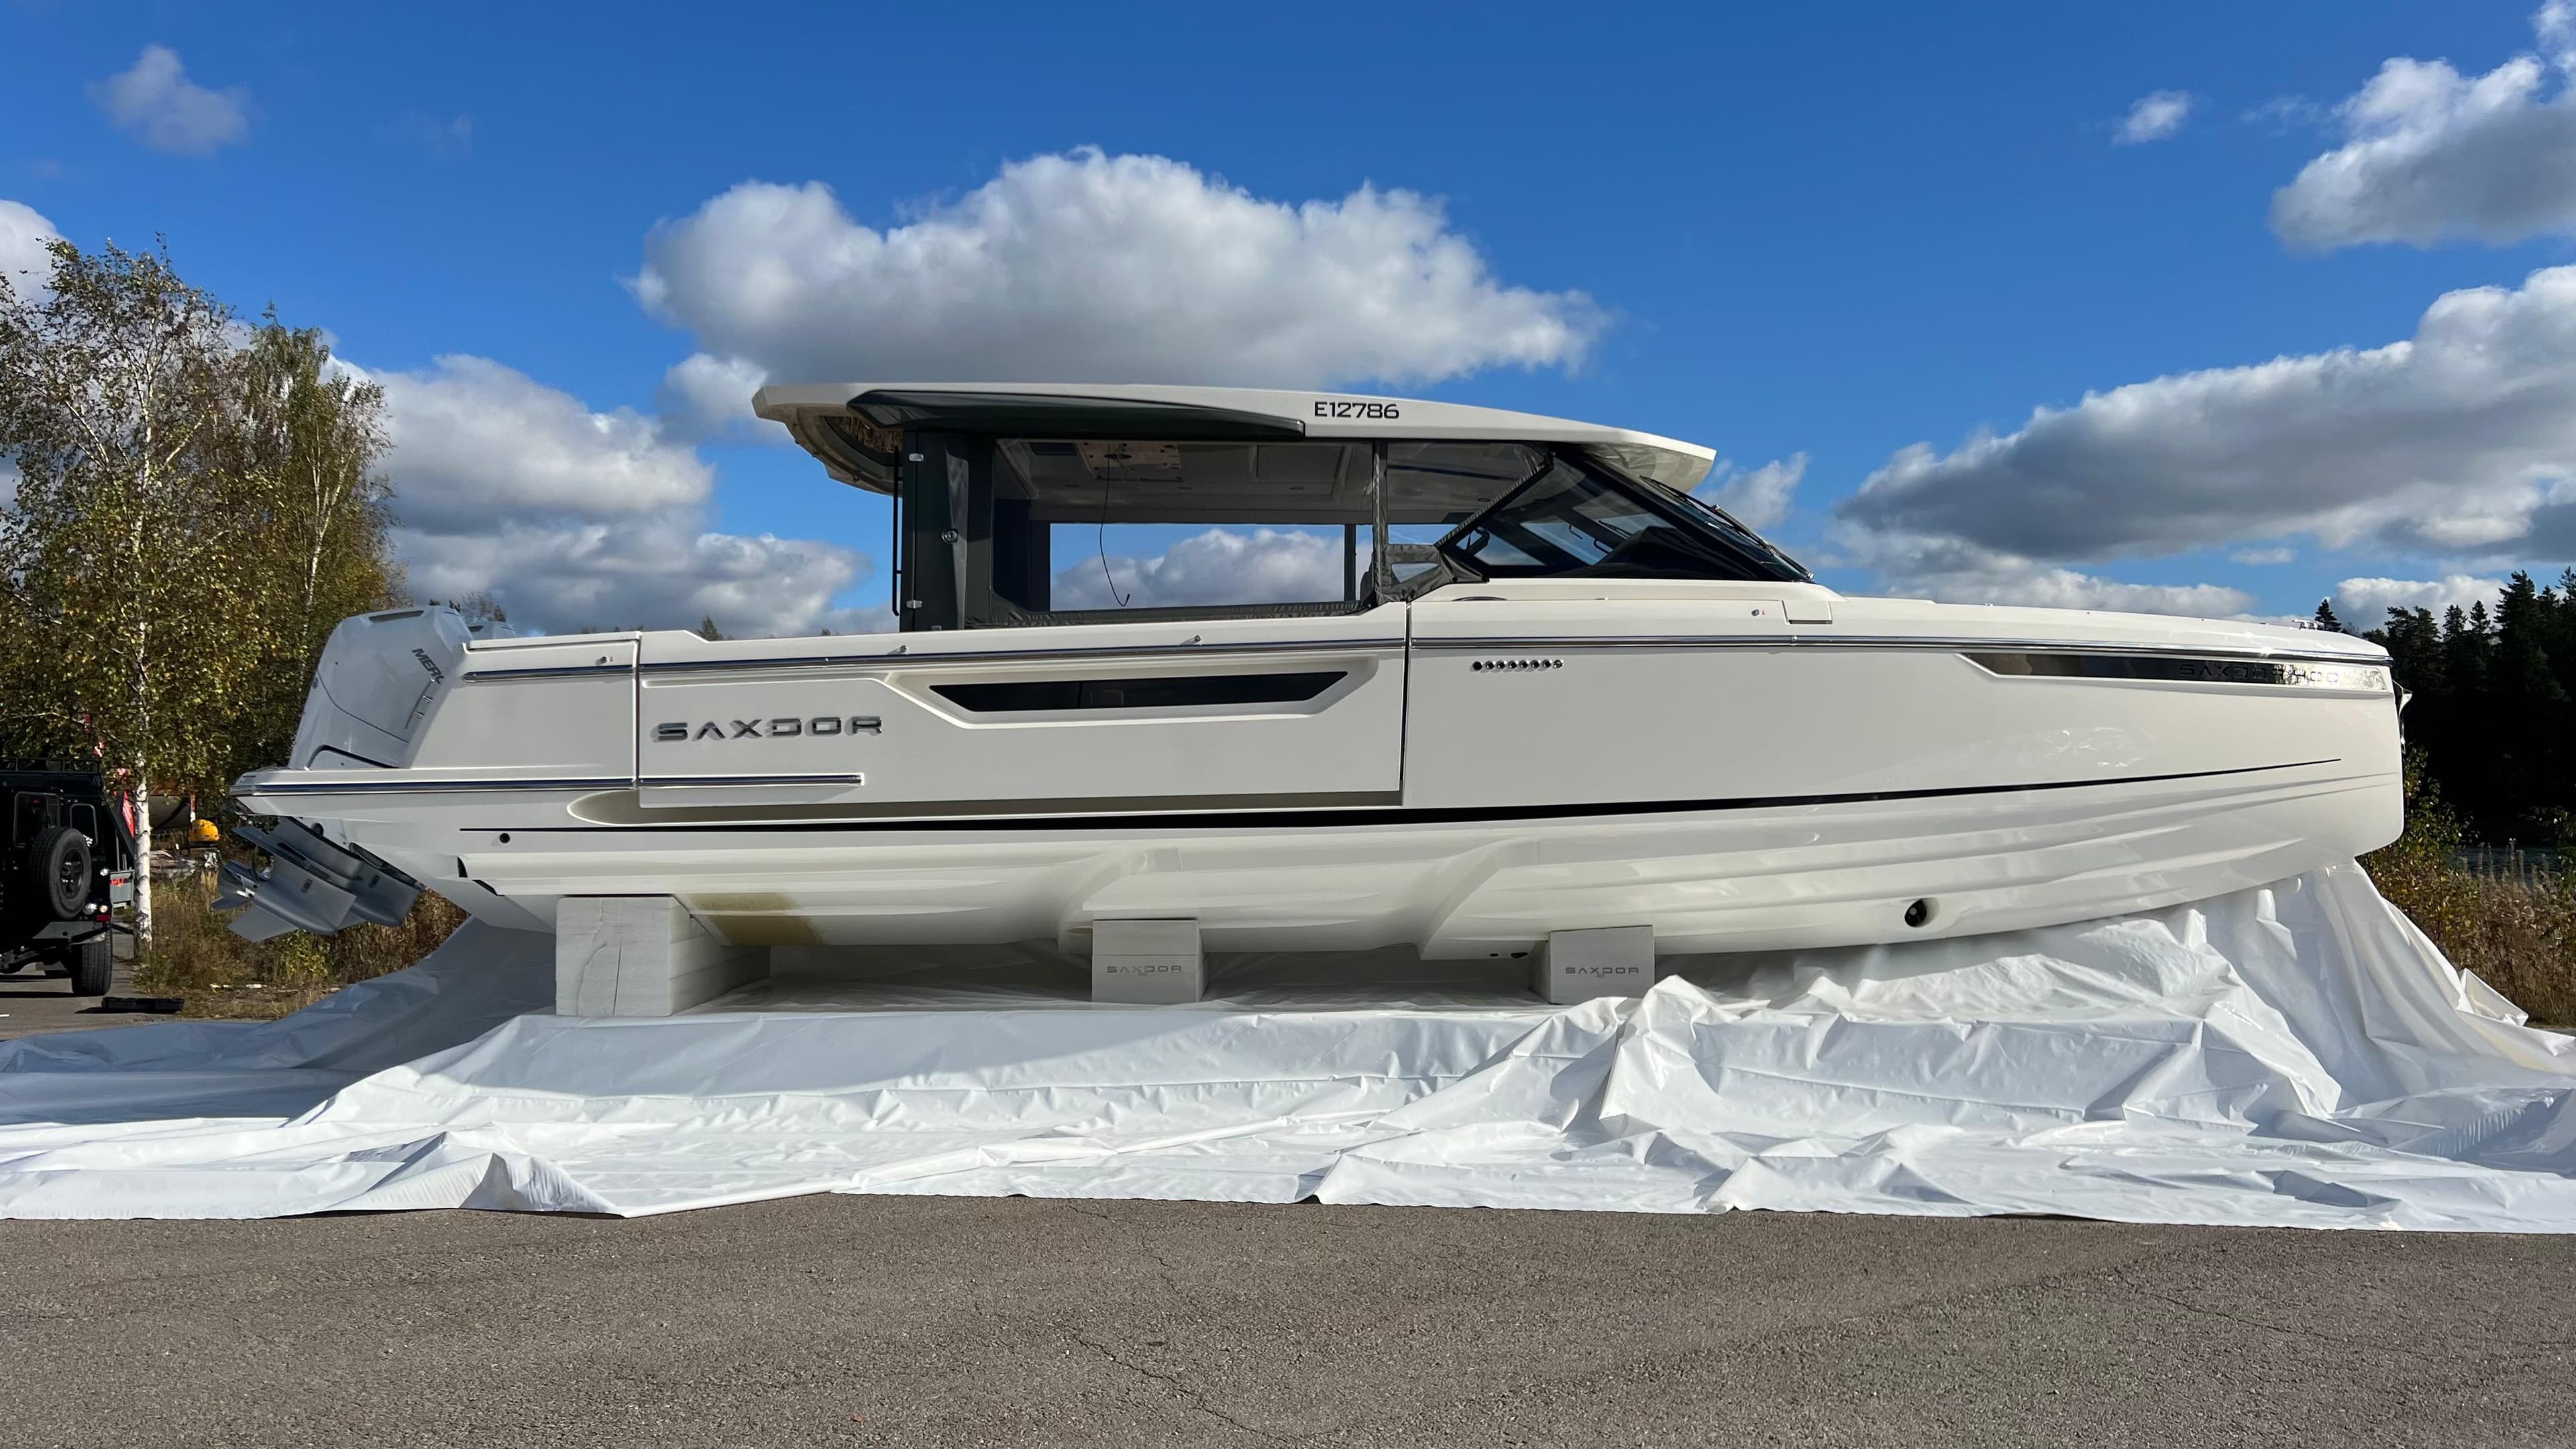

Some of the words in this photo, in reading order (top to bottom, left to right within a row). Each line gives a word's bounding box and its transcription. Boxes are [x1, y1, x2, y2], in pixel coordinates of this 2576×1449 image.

[1314, 401, 1400, 419] E12786
[2180, 663, 2284, 681] SAXDOR
[657, 716, 883, 741] SAXDOR
[1106, 965, 1182, 973] SAXDOR
